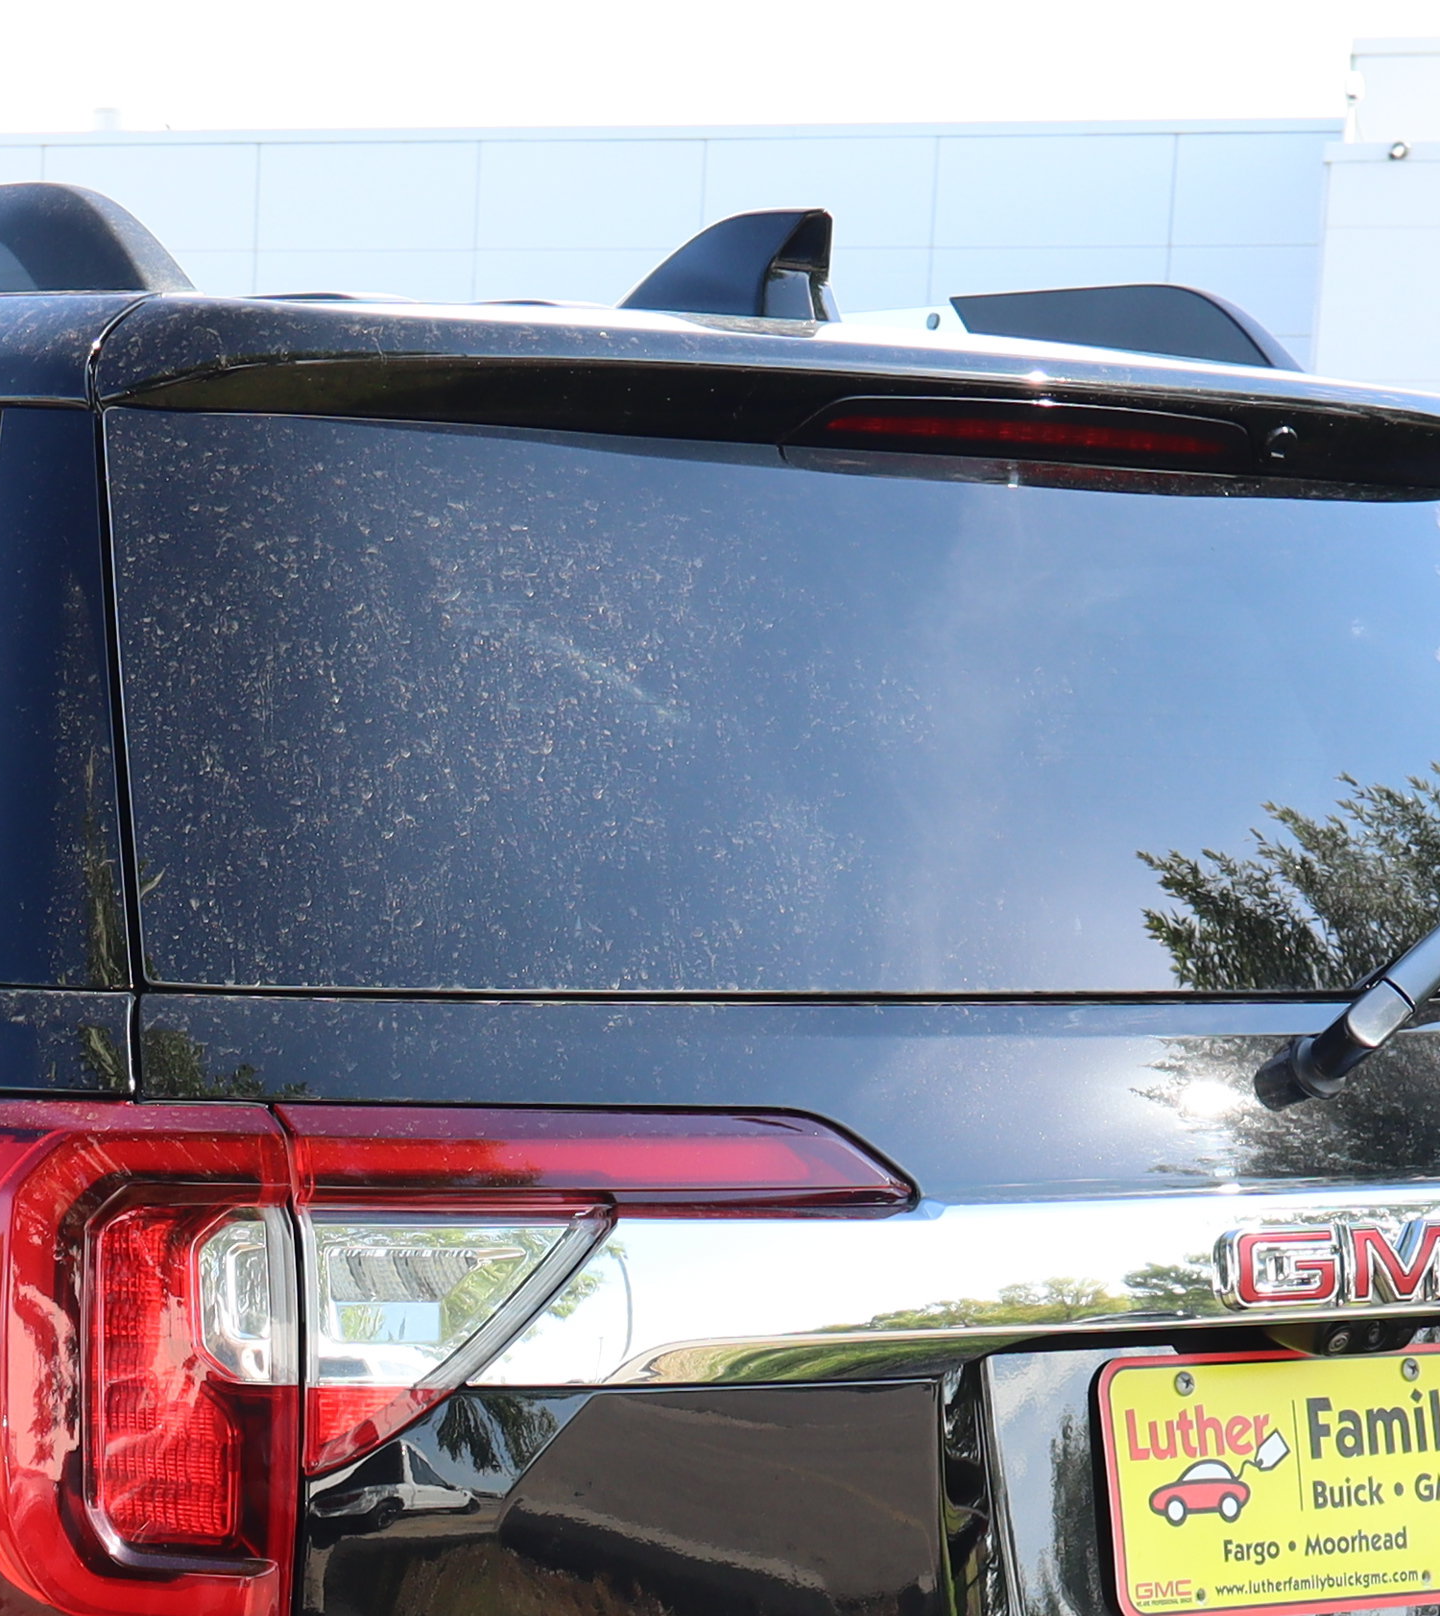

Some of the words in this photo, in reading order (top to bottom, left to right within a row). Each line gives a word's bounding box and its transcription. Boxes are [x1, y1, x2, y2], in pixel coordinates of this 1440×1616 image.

[1124, 1404, 1270, 1462] Luther
[1313, 1475, 1385, 1510] Buick
[1223, 1538, 1281, 1566] Fargo
[1304, 1526, 1408, 1557] Moorhead
[1135, 1579, 1193, 1599] GMC
[1215, 1569, 1419, 1596] www.lutherfamilybuickgmc.com
